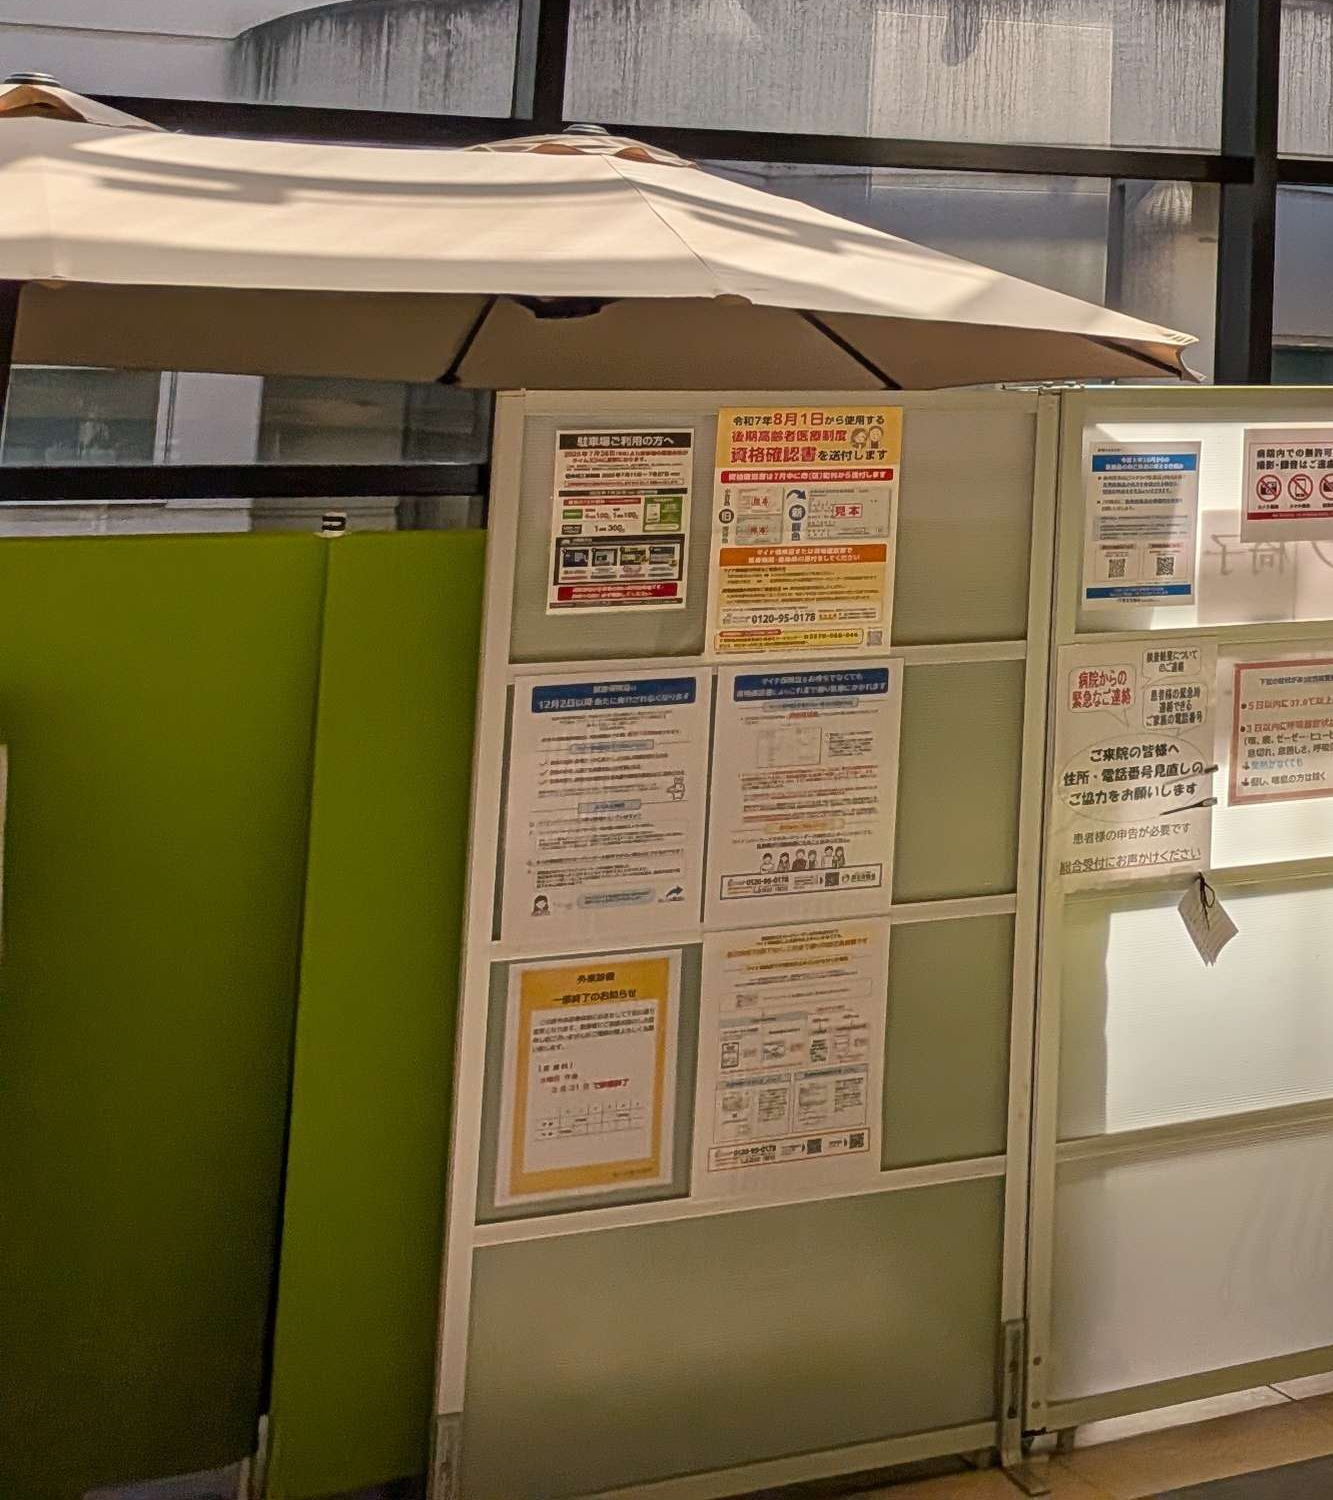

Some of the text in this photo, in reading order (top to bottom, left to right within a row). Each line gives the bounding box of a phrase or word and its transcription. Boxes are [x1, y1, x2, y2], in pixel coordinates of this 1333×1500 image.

[731, 446, 888, 463] 資格確認書を送付します
[751, 612, 816, 624] 0120-95-0178
[1078, 669, 1127, 689] 病院からの
[1071, 688, 1131, 709] 緊急なご連絡
[1090, 743, 1180, 762] ご来院の皆様へ
[1063, 761, 1204, 787] 住所・電話番号見直しの
[1069, 782, 1198, 807] ご協力をお願いします
[1073, 822, 1191, 845] 患者様の申告が必要です
[1059, 847, 1202, 874] 総合受付にお声かけください
